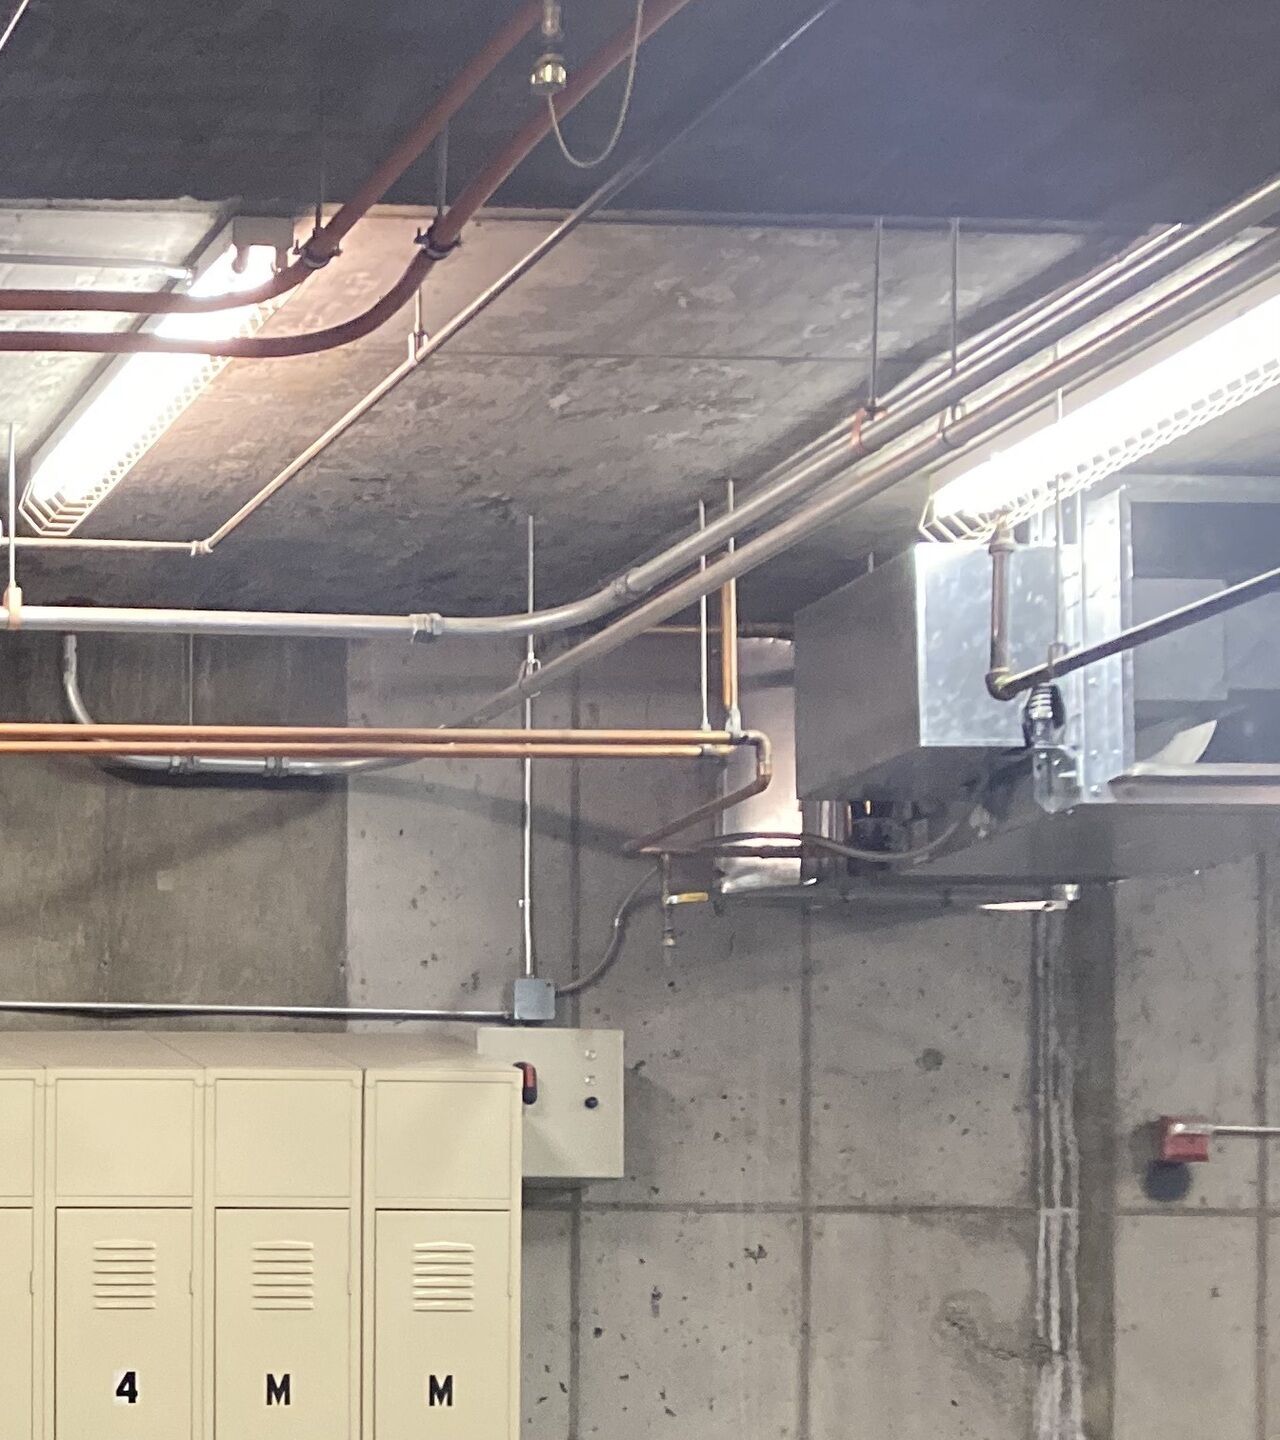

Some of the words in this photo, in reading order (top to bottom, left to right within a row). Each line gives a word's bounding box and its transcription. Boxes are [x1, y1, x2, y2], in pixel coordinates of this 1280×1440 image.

[115, 1371, 138, 1404] 4
[266, 1373, 291, 1406] M
[429, 1374, 453, 1407] M
